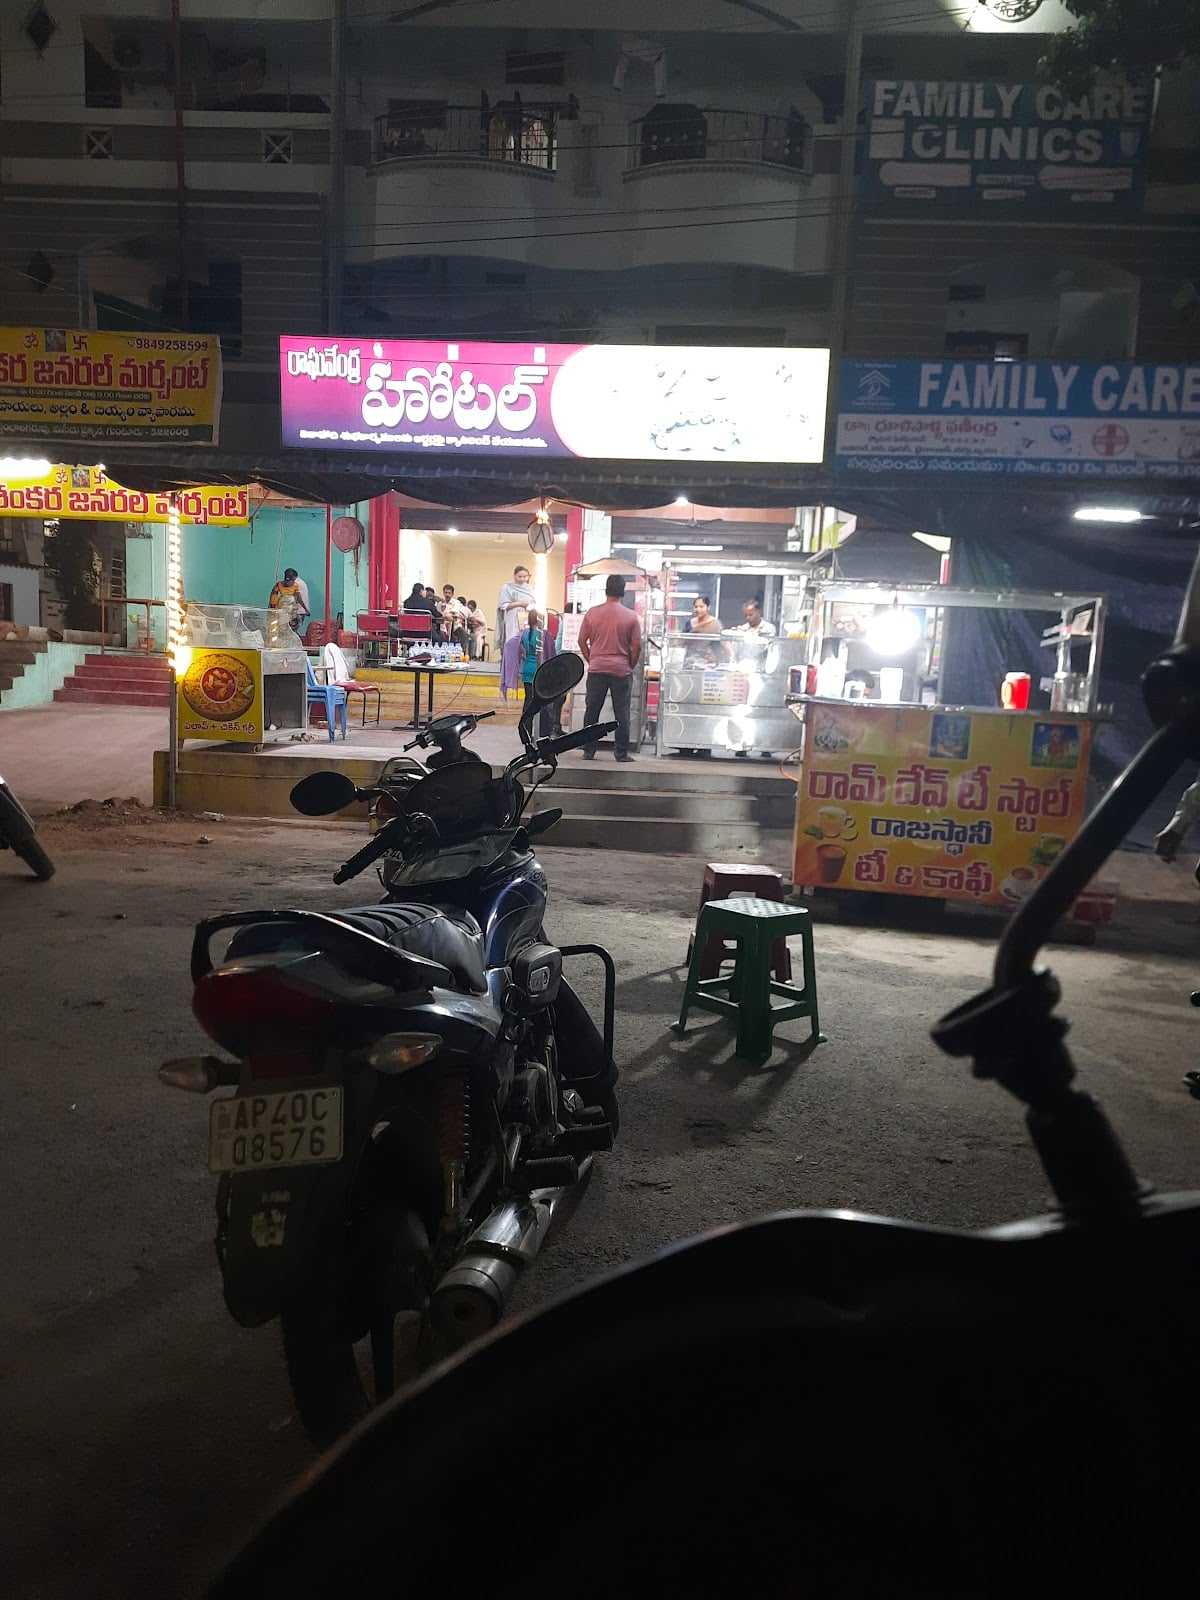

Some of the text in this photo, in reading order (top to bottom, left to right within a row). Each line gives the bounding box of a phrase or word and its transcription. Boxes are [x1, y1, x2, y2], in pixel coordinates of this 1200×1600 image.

[873, 80, 1147, 120] FAMILY CARE
[911, 124, 1103, 162] CLINICS
[136, 338, 208, 351] 9849258599
[287, 344, 361, 384] రాఘవేంద్ర
[33, 354, 114, 387] జనరల్
[119, 357, 211, 400] మర్చంట్
[917, 363, 1200, 414] FAMILY CARE
[80, 402, 90, 415] &
[210, 722, 218, 730] +
[808, 763, 1073, 833] రామ్ దేవ్ టీ స్టాల్
[870, 817, 992, 856] రాజస్థానీ
[854, 850, 887, 884] టీ
[922, 862, 993, 896] కాఫీ
[234, 1091, 328, 1130] AP40C
